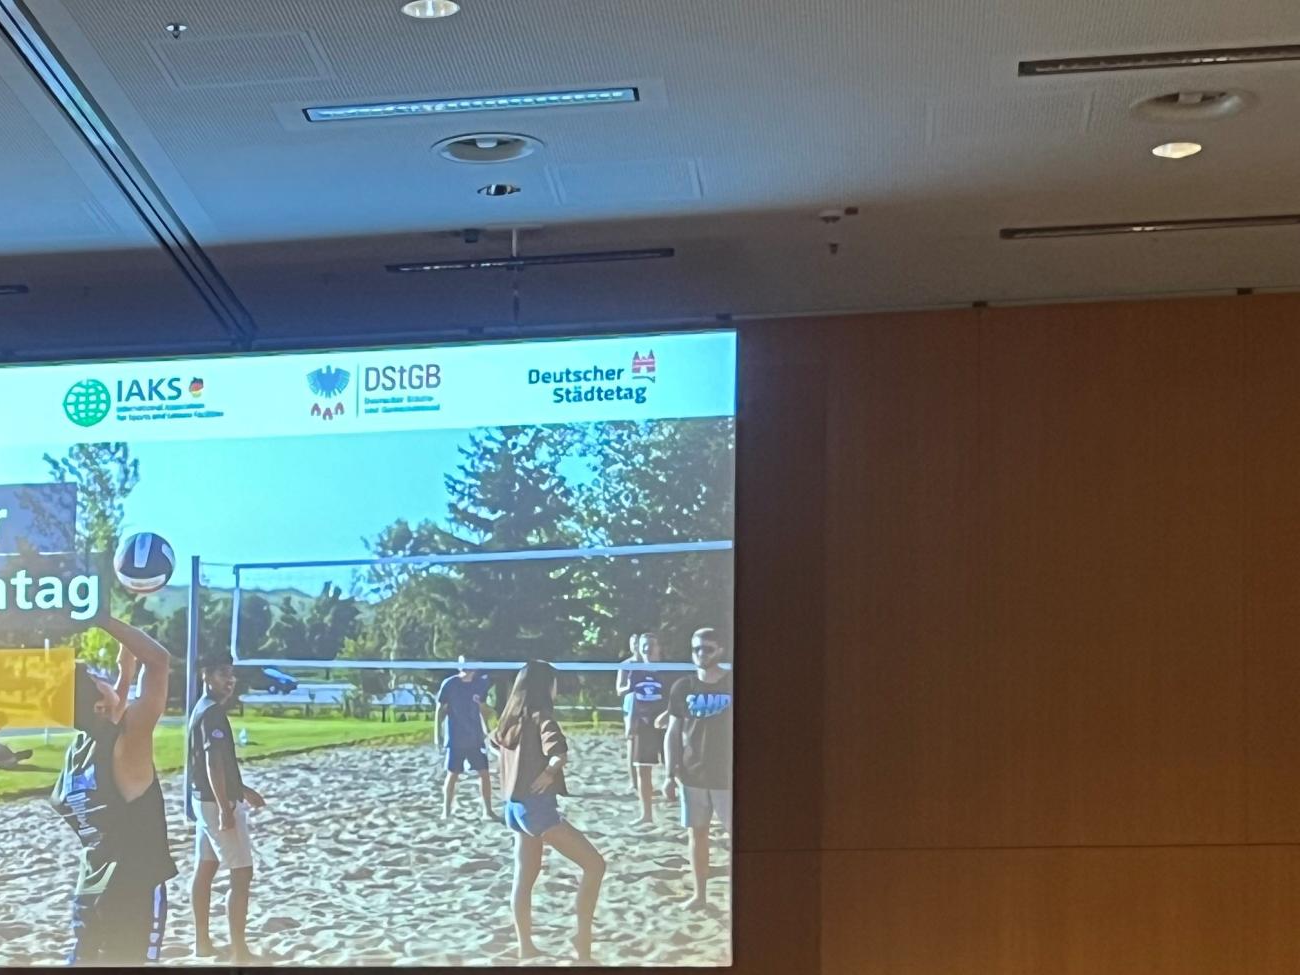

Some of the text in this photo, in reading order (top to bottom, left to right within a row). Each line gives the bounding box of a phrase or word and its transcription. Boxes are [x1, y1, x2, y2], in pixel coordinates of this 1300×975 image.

[364, 364, 441, 391] DStGB
[528, 365, 625, 384] Deutscher
[116, 377, 182, 402] IAKS
[553, 385, 647, 404] Städtetag
